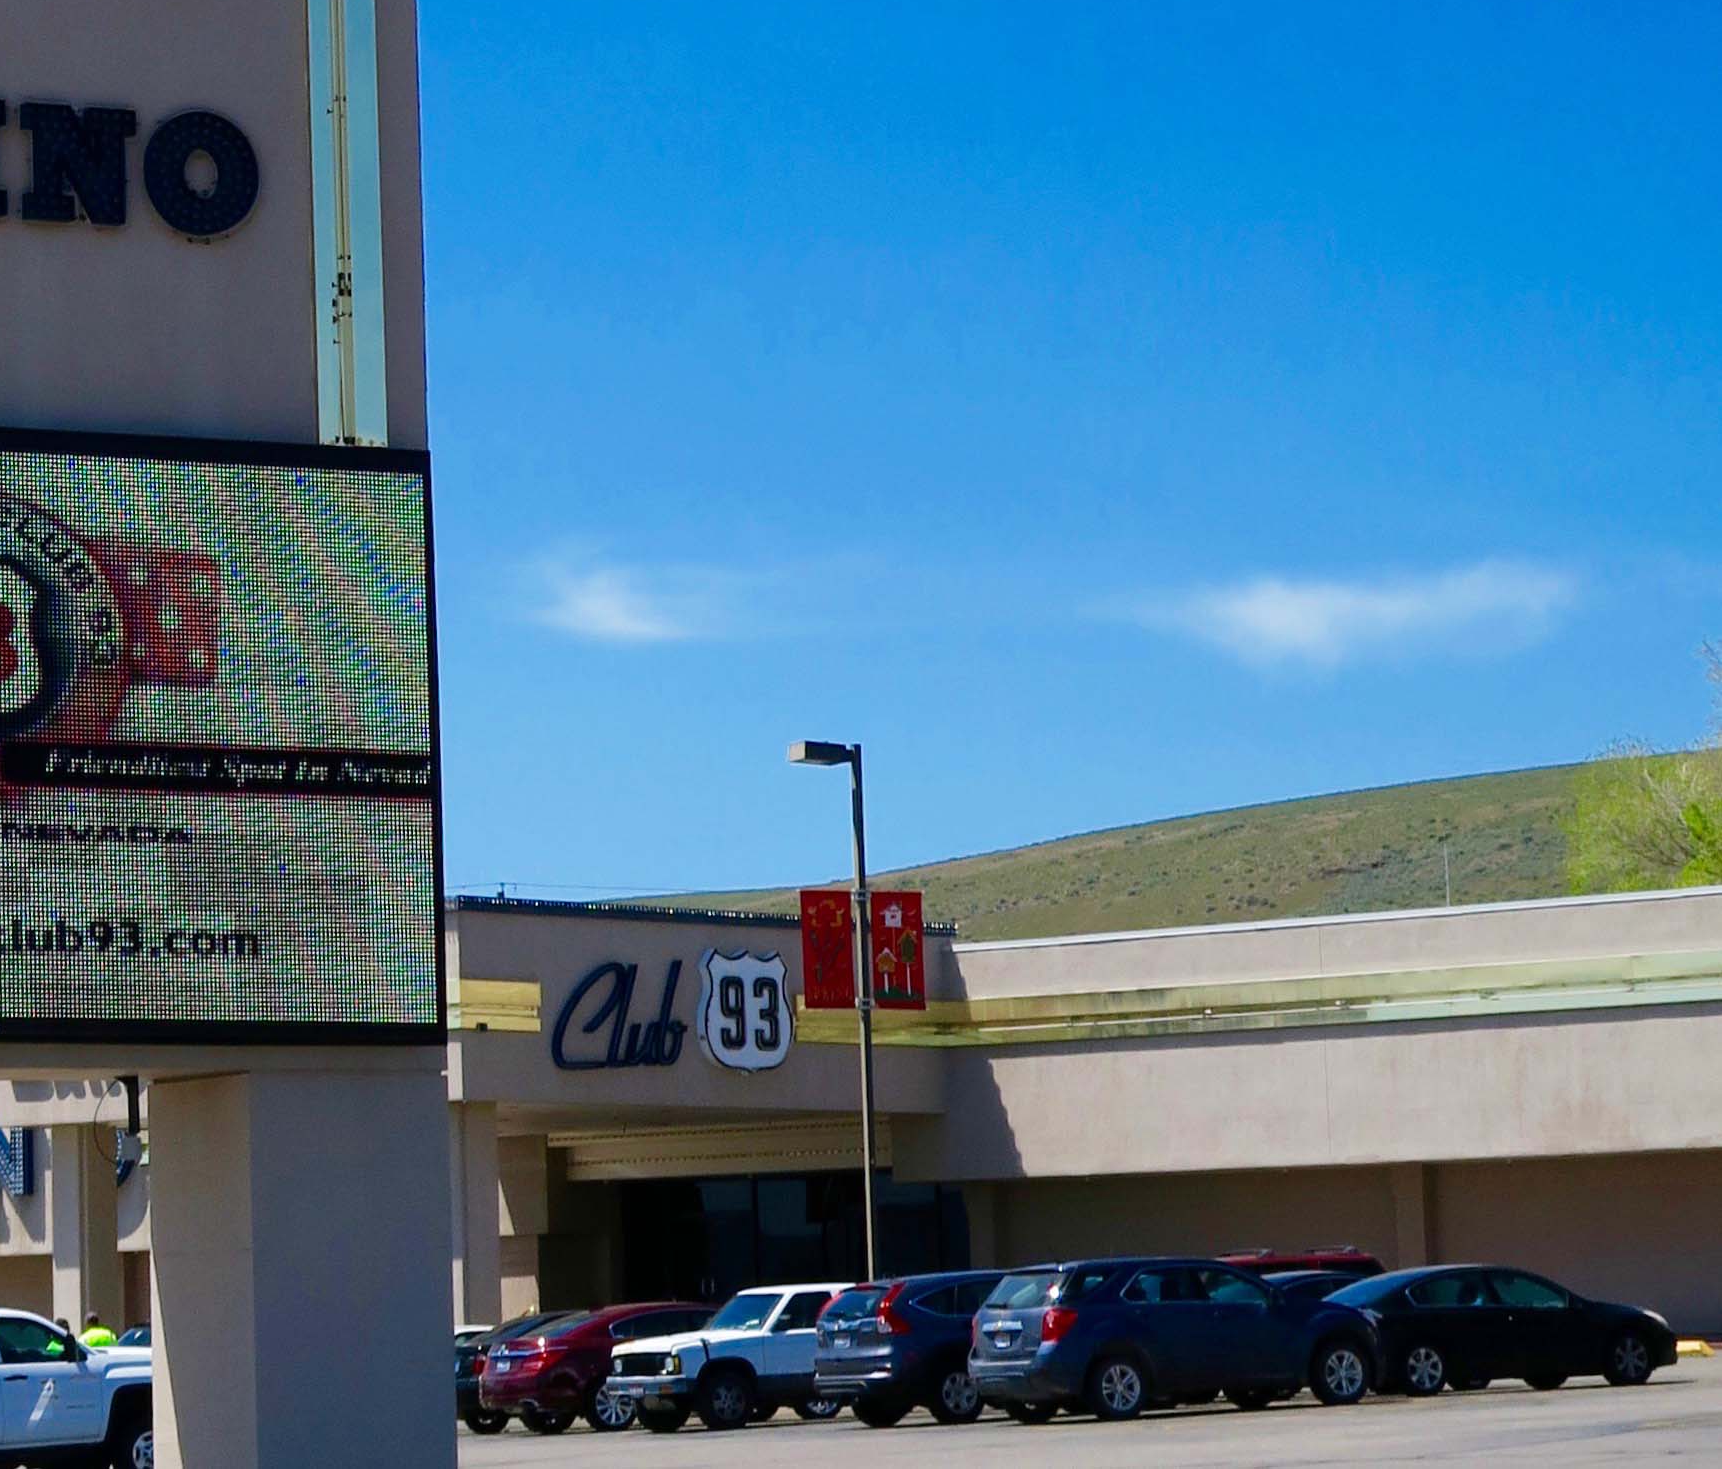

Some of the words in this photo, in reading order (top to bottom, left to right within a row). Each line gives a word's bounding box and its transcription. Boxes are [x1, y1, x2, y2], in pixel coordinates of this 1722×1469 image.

[1, 821, 193, 845] NEVADA
[551, 960, 689, 1070] Club
[719, 975, 782, 1052] 93
